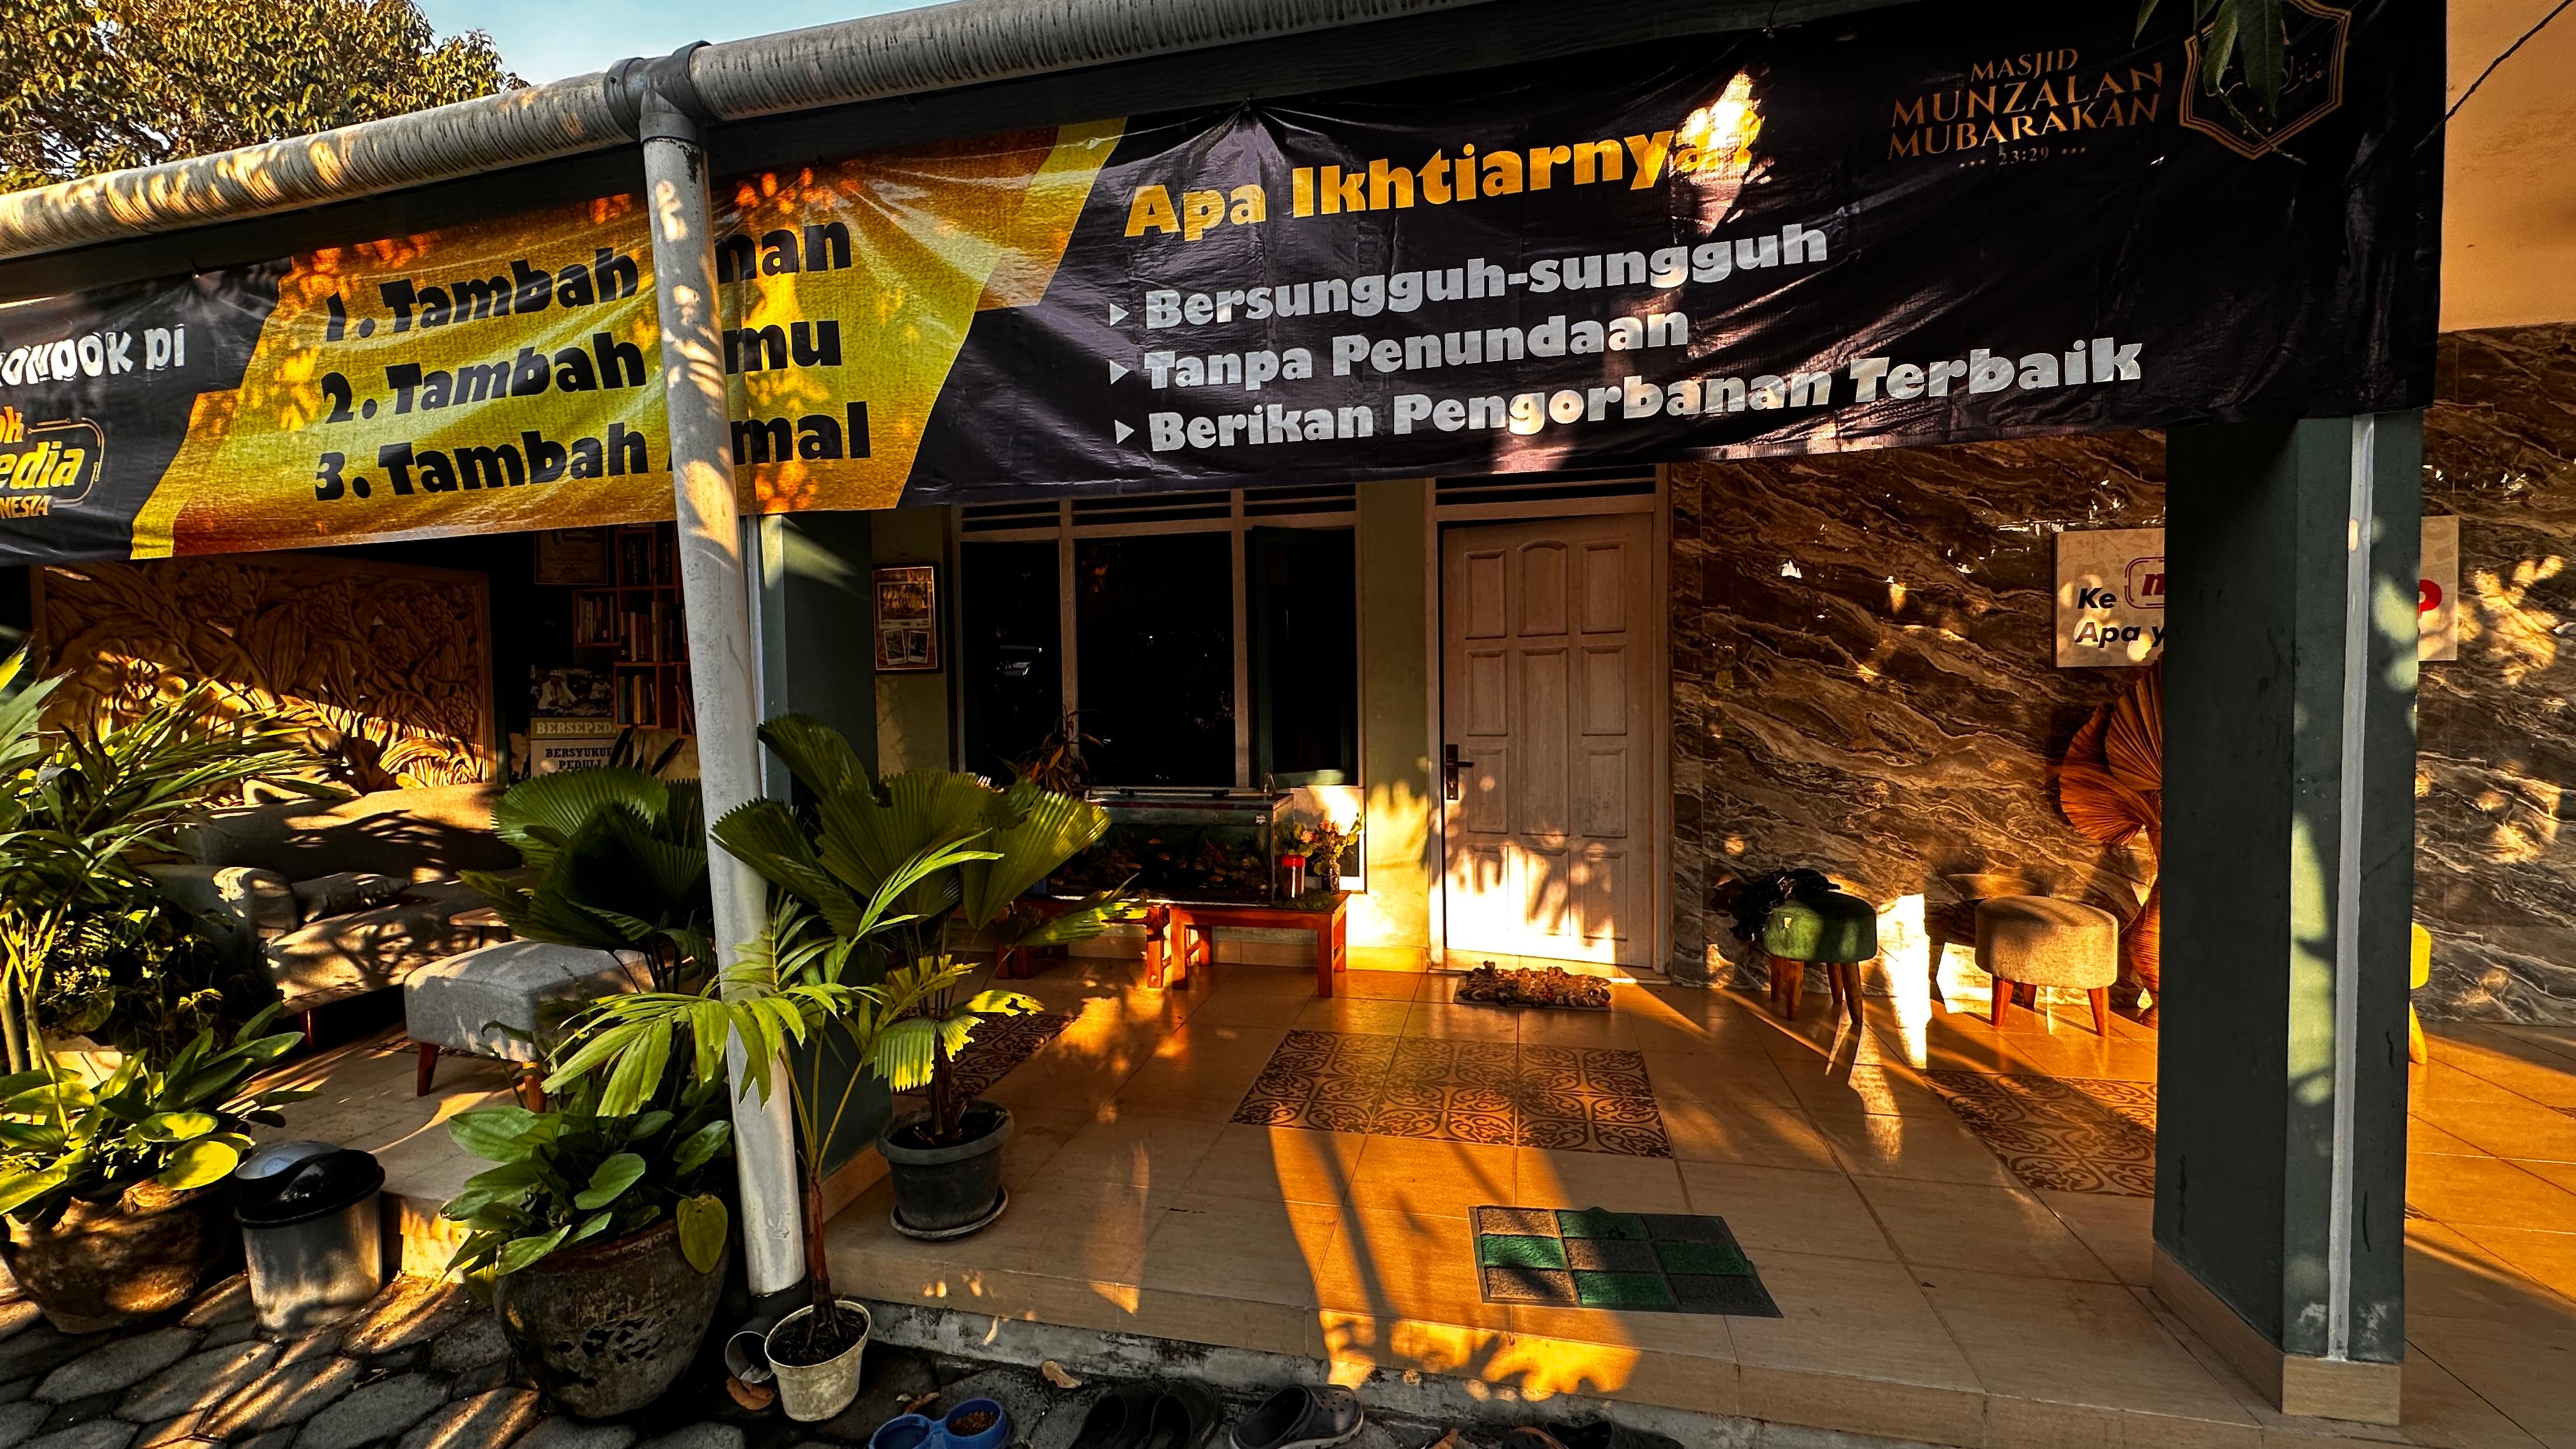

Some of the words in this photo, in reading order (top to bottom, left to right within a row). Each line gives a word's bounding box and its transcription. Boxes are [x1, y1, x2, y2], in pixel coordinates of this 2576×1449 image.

[1890, 61, 2163, 128] MUNZALAN
[1971, 48, 2079, 82] MASJID
[1887, 93, 2161, 160] MUBARAKAN
[1998, 146, 2050, 165] 23:29
[1124, 183, 1268, 242] Apa
[326, 291, 376, 342] 1.
[379, 247, 639, 333] Tambah
[714, 222, 852, 284] man
[1146, 224, 1828, 331] Bersungguh-sungguh
[0, 332, 133, 386] ONDOK
[321, 372, 378, 424] 2.
[385, 332, 647, 415] Tambah
[1144, 342, 1313, 392] Tanpa
[1331, 308, 1689, 377] Penundaan
[1149, 404, 1375, 452] Berikan
[1393, 368, 1832, 436] Pengorbanan
[1850, 337, 2143, 403] Terbaik
[315, 452, 371, 502] 3.
[378, 422, 649, 495] Tambah
[666, 401, 871, 471] mal
[2078, 587, 2117, 609] Ke
[2074, 622, 2141, 648] Apa
